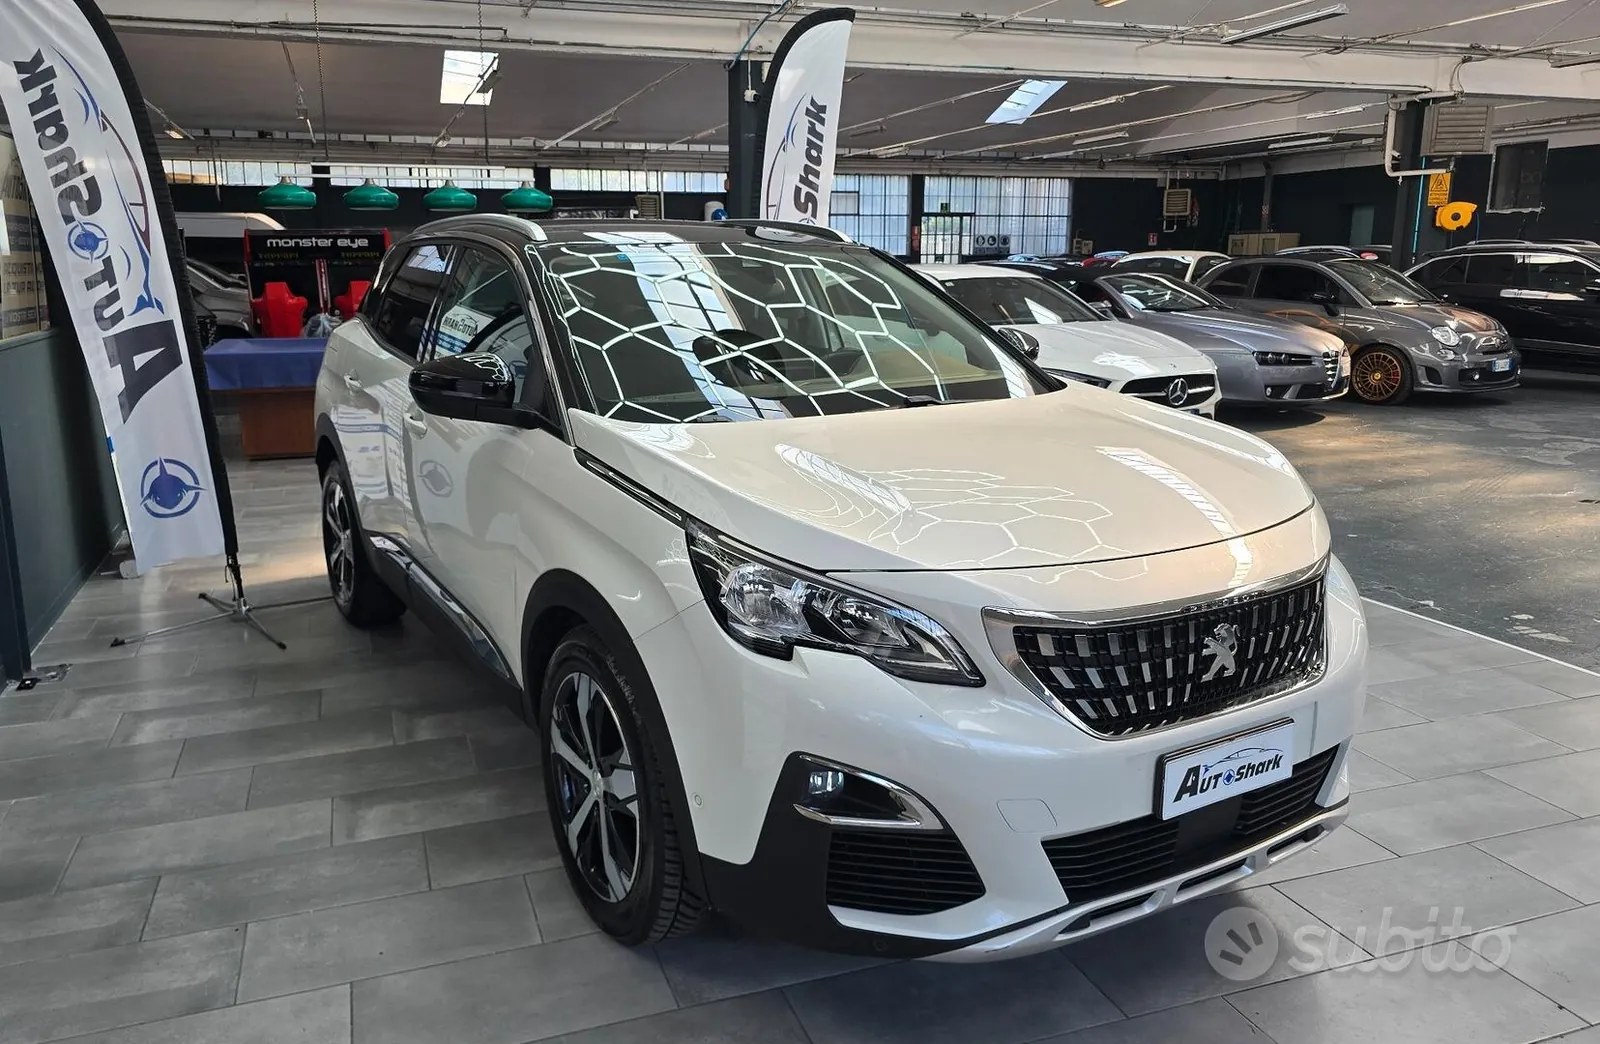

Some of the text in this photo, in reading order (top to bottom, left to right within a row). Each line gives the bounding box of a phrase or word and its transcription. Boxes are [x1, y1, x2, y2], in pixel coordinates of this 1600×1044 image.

[793, 95, 828, 221] Shark
[266, 237, 369, 249] monster eye
